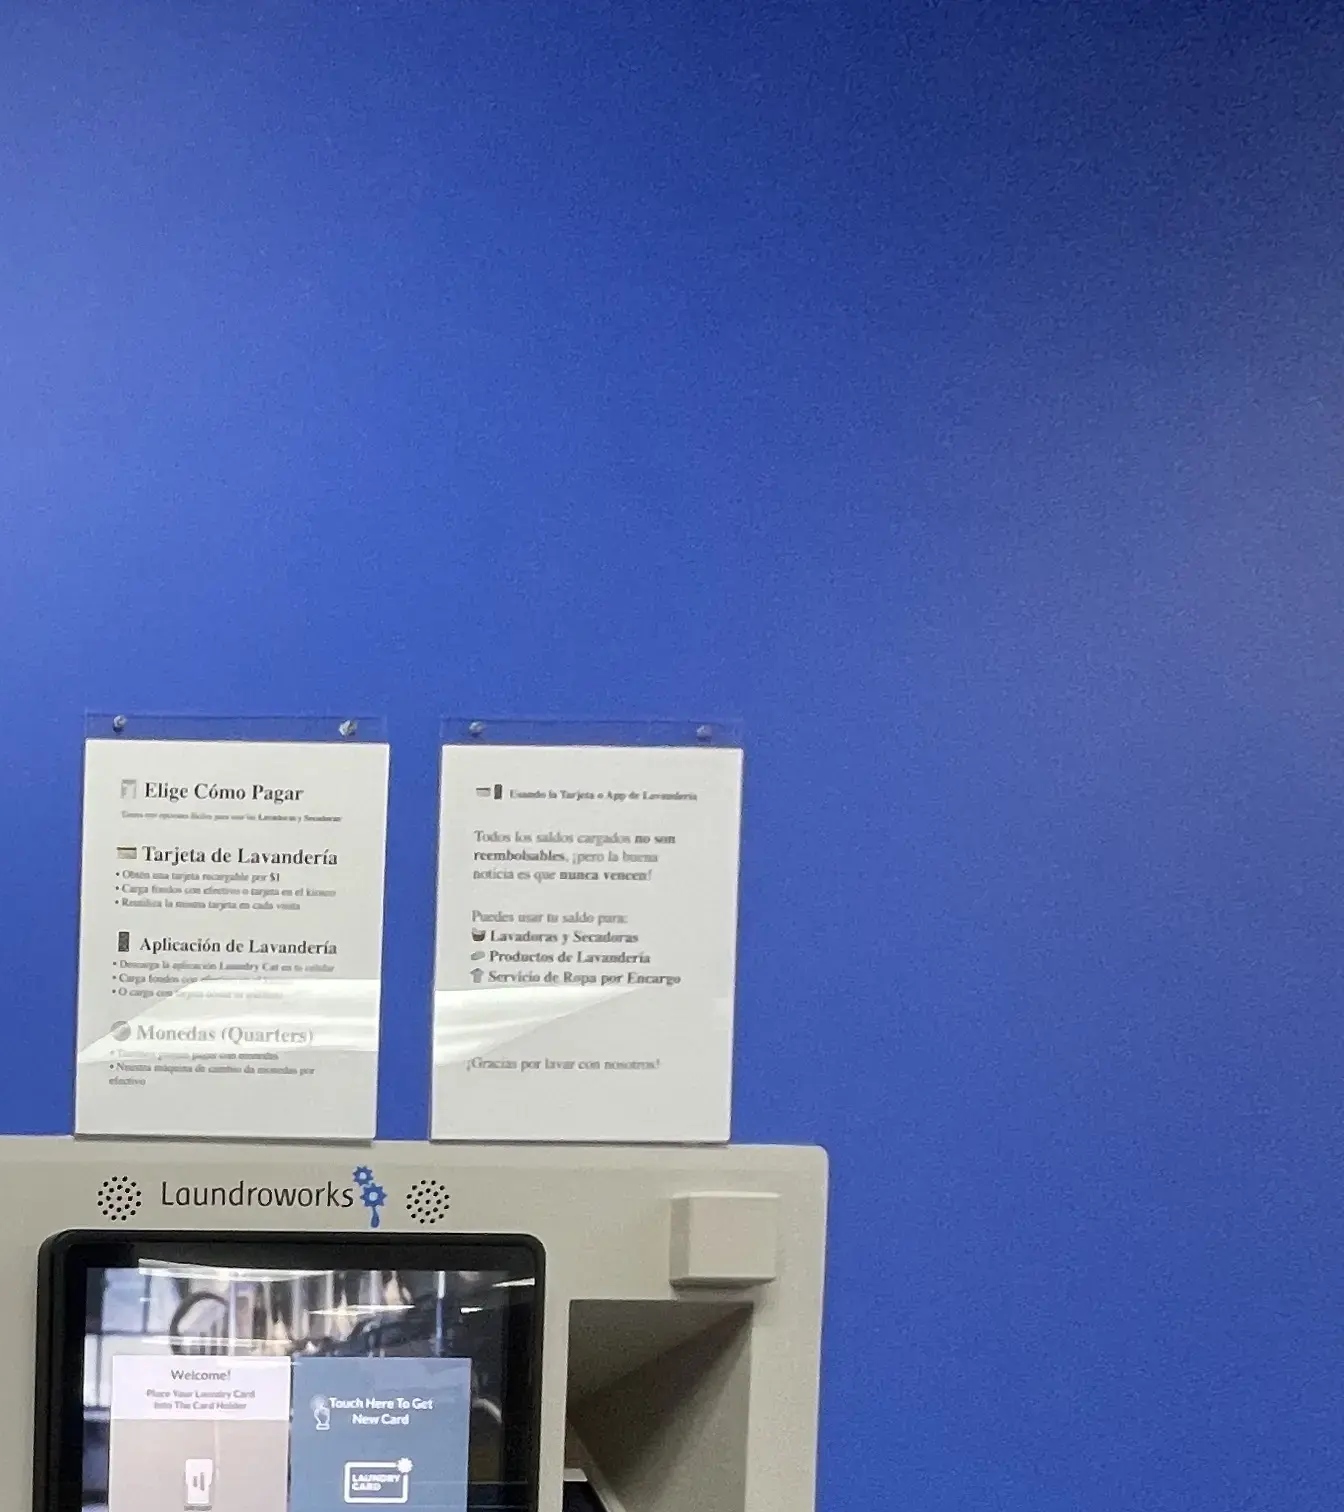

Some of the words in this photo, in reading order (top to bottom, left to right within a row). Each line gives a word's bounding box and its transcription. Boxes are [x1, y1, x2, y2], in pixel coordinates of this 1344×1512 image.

[144, 782, 189, 801] Elige
[193, 783, 246, 800] Cómo
[252, 784, 301, 804] Pagar
[473, 829, 512, 843] Todos
[514, 831, 533, 843] los
[535, 831, 574, 844] saldos
[576, 832, 632, 847] cargados
[634, 835, 651, 844] no
[653, 835, 676, 844] son
[140, 846, 206, 867] Tarjeta
[210, 847, 232, 863] de
[238, 848, 337, 866] Lavandería
[472, 848, 569, 862] reembolsables,
[607, 850, 620, 863] la
[622, 850, 658, 863] buena
[471, 867, 515, 880] noticia
[516, 871, 532, 881] es
[531, 870, 557, 884] que
[559, 871, 600, 881] nunca
[603, 869, 652, 881] vencen!
[138, 937, 221, 955] Aplicación
[225, 939, 244, 953] de
[249, 939, 337, 955] Lavandería
[489, 929, 558, 943] Lavadoras
[561, 933, 569, 946] y
[572, 930, 638, 944] Secadoras
[488, 949, 554, 963] Productos
[557, 951, 573, 963] de
[576, 950, 650, 964] Lavandería
[486, 970, 541, 983] Servicio
[543, 970, 560, 984] de
[563, 970, 597, 987] Ropa
[600, 974, 624, 987] por
[626, 971, 681, 986] Encargo
[135, 1024, 216, 1042] Monedas
[221, 1026, 315, 1046] (Quarters)
[160, 1178, 356, 1208] Laundroworks
[169, 1369, 231, 1381] Welcome!
[328, 1397, 365, 1411] Touch
[365, 1397, 395, 1410] Here
[396, 1397, 410, 1409] To
[411, 1397, 433, 1410] Get
[350, 1413, 380, 1425] New
[379, 1413, 409, 1425] Card
